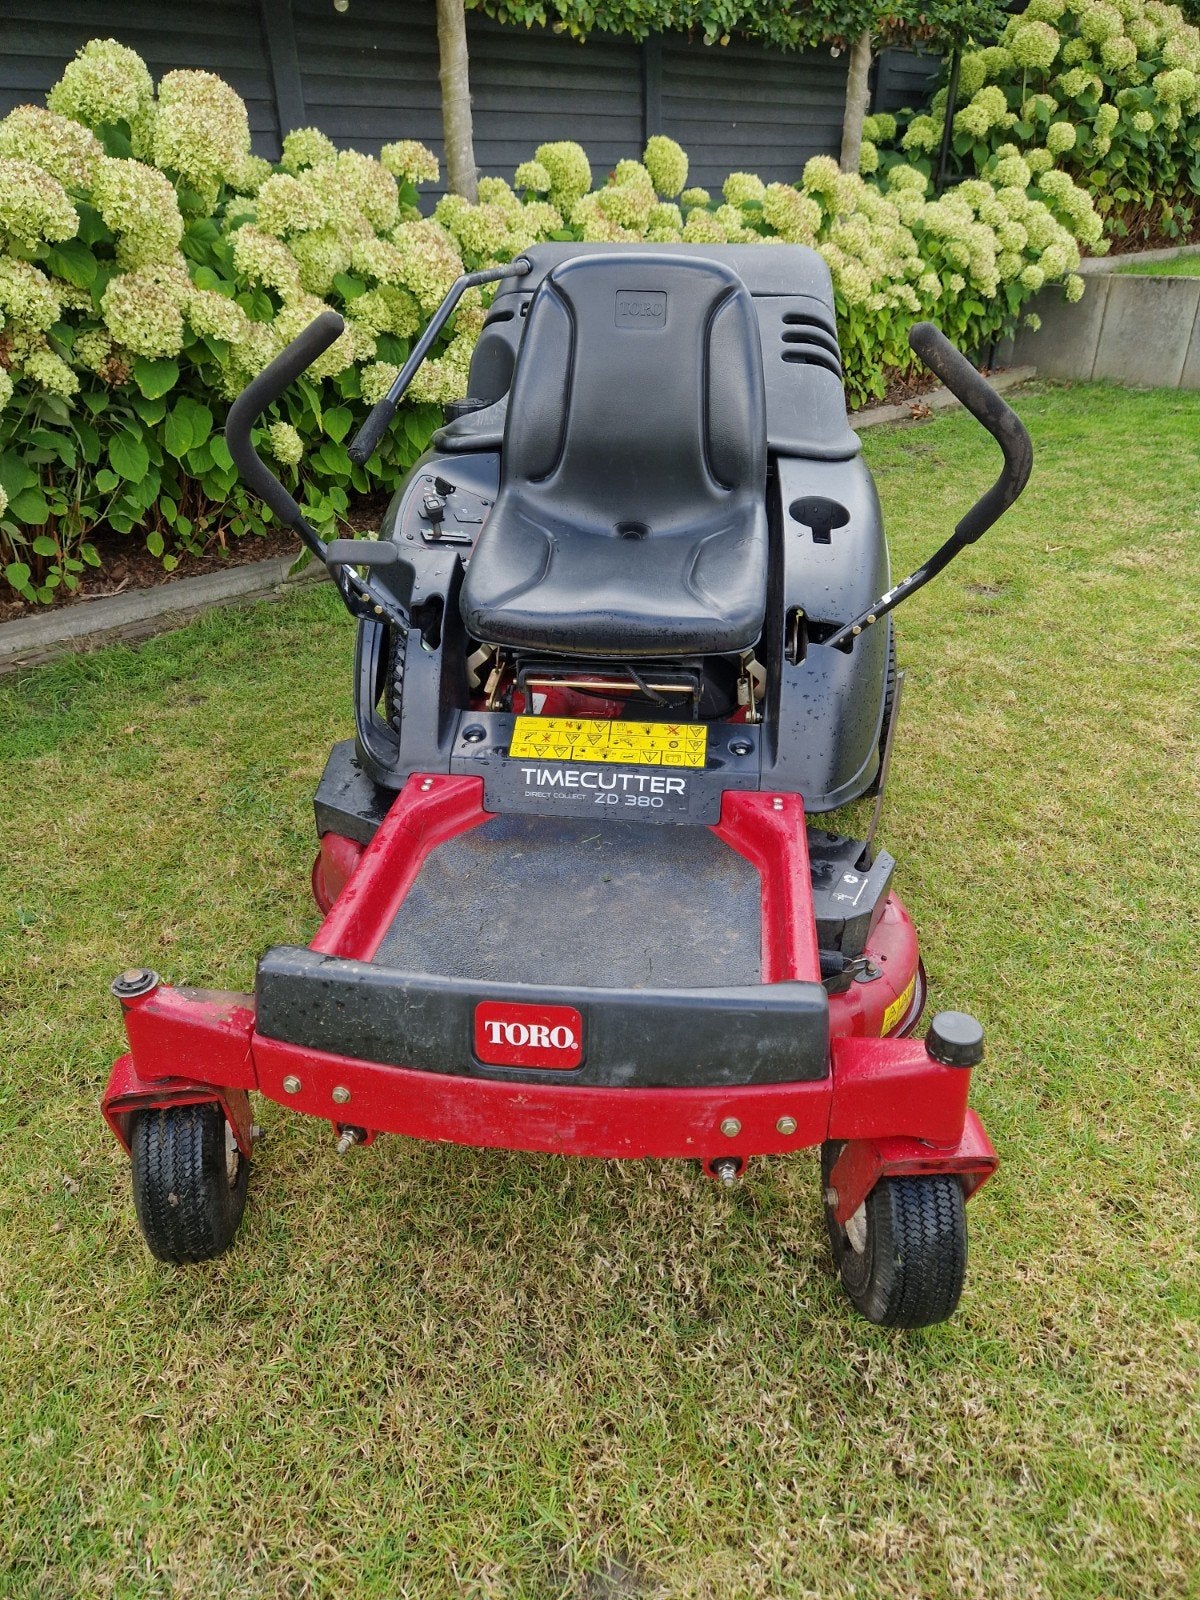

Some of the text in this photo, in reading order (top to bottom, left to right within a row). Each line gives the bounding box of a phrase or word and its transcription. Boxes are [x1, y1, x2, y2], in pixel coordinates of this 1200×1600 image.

[619, 302, 664, 317] TORO
[521, 768, 686, 795] TIMECUTTER
[524, 790, 664, 808] DIRECT COLLECT ZD 380
[484, 1021, 574, 1049] TORO
